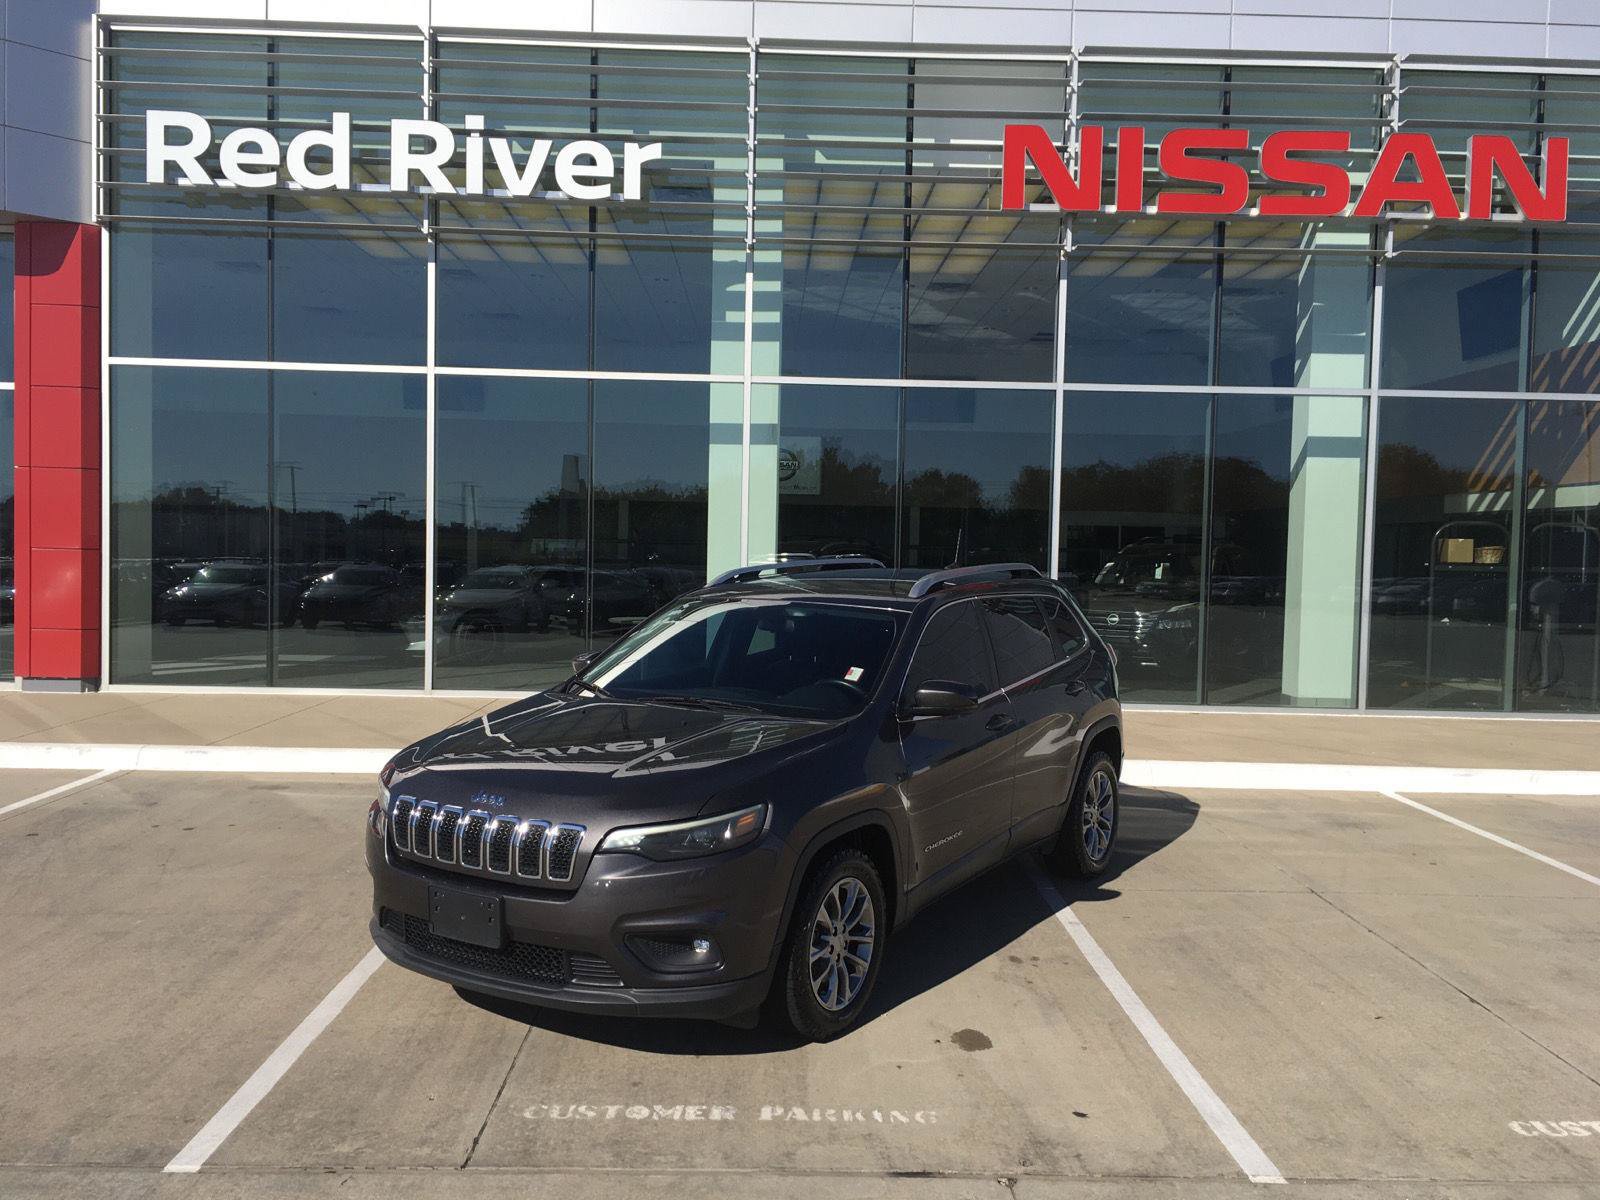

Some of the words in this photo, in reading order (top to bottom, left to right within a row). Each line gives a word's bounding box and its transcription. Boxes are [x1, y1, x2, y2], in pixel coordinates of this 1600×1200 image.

[146, 109, 351, 190] Red
[391, 114, 662, 200] River
[1001, 123, 1570, 221] NISSAN
[924, 830, 963, 852] CHEROKEE
[522, 1104, 735, 1120] CUSTOMER
[758, 1104, 938, 1124] PARKING
